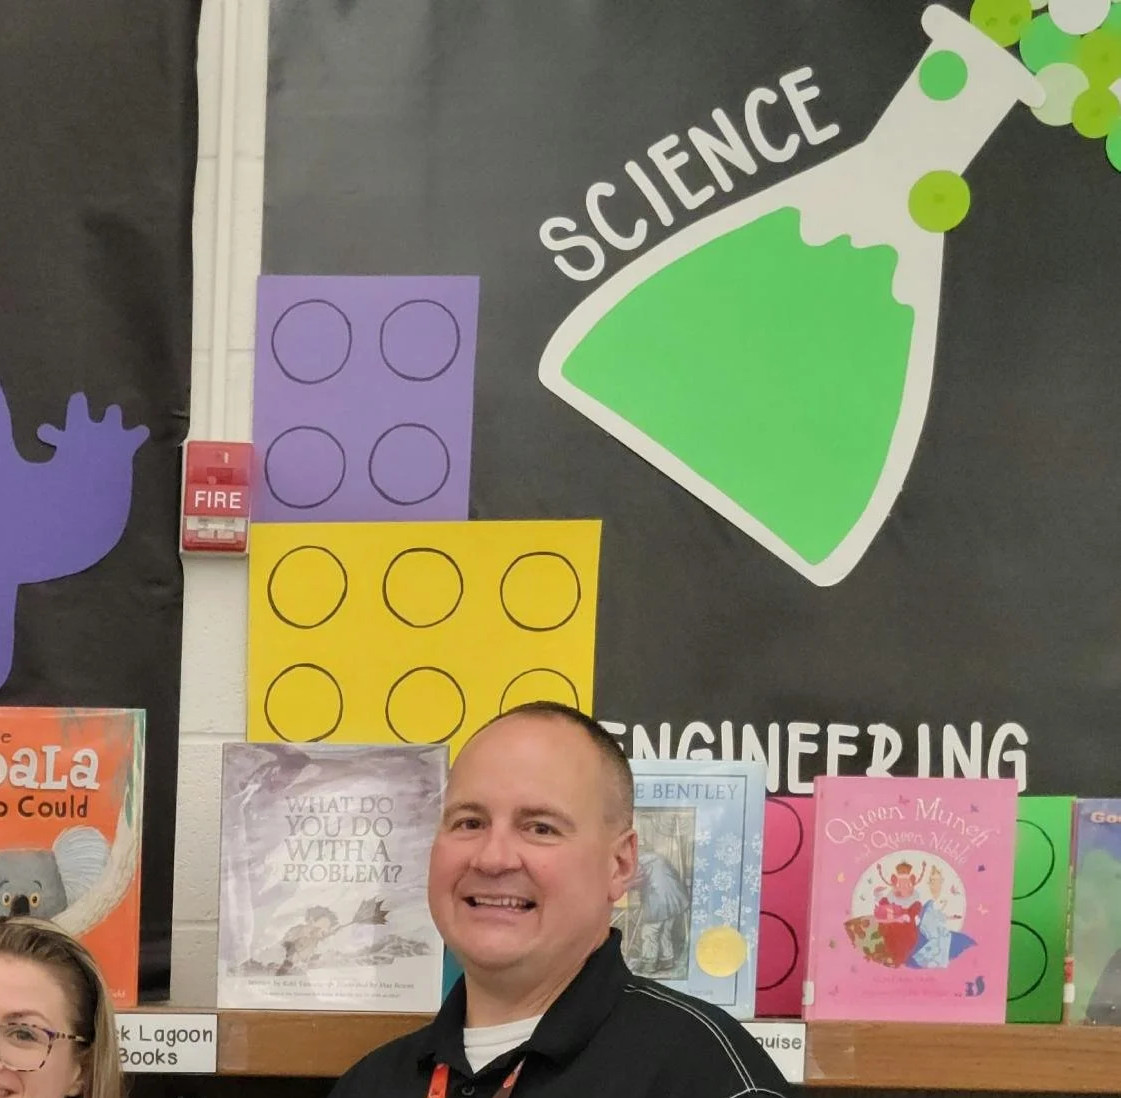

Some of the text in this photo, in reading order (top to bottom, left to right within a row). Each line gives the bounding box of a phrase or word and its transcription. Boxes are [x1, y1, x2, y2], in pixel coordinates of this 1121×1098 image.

[539, 66, 840, 281] SCIENCE
[194, 490, 242, 509] FIRE
[601, 721, 1029, 794] ENGINEERING
[652, 783, 738, 801] BENTLEY
[17, 795, 88, 818] Could
[285, 796, 394, 815] WHAT DO
[285, 815, 394, 837] YOU DO
[825, 797, 1001, 850] Queen Munch
[284, 839, 392, 862] WITH A
[870, 829, 970, 866] Queen Nibble
[282, 863, 403, 884] PROBLEM?
[139, 1024, 212, 1046] Lagoon
[119, 1048, 177, 1066] Books
